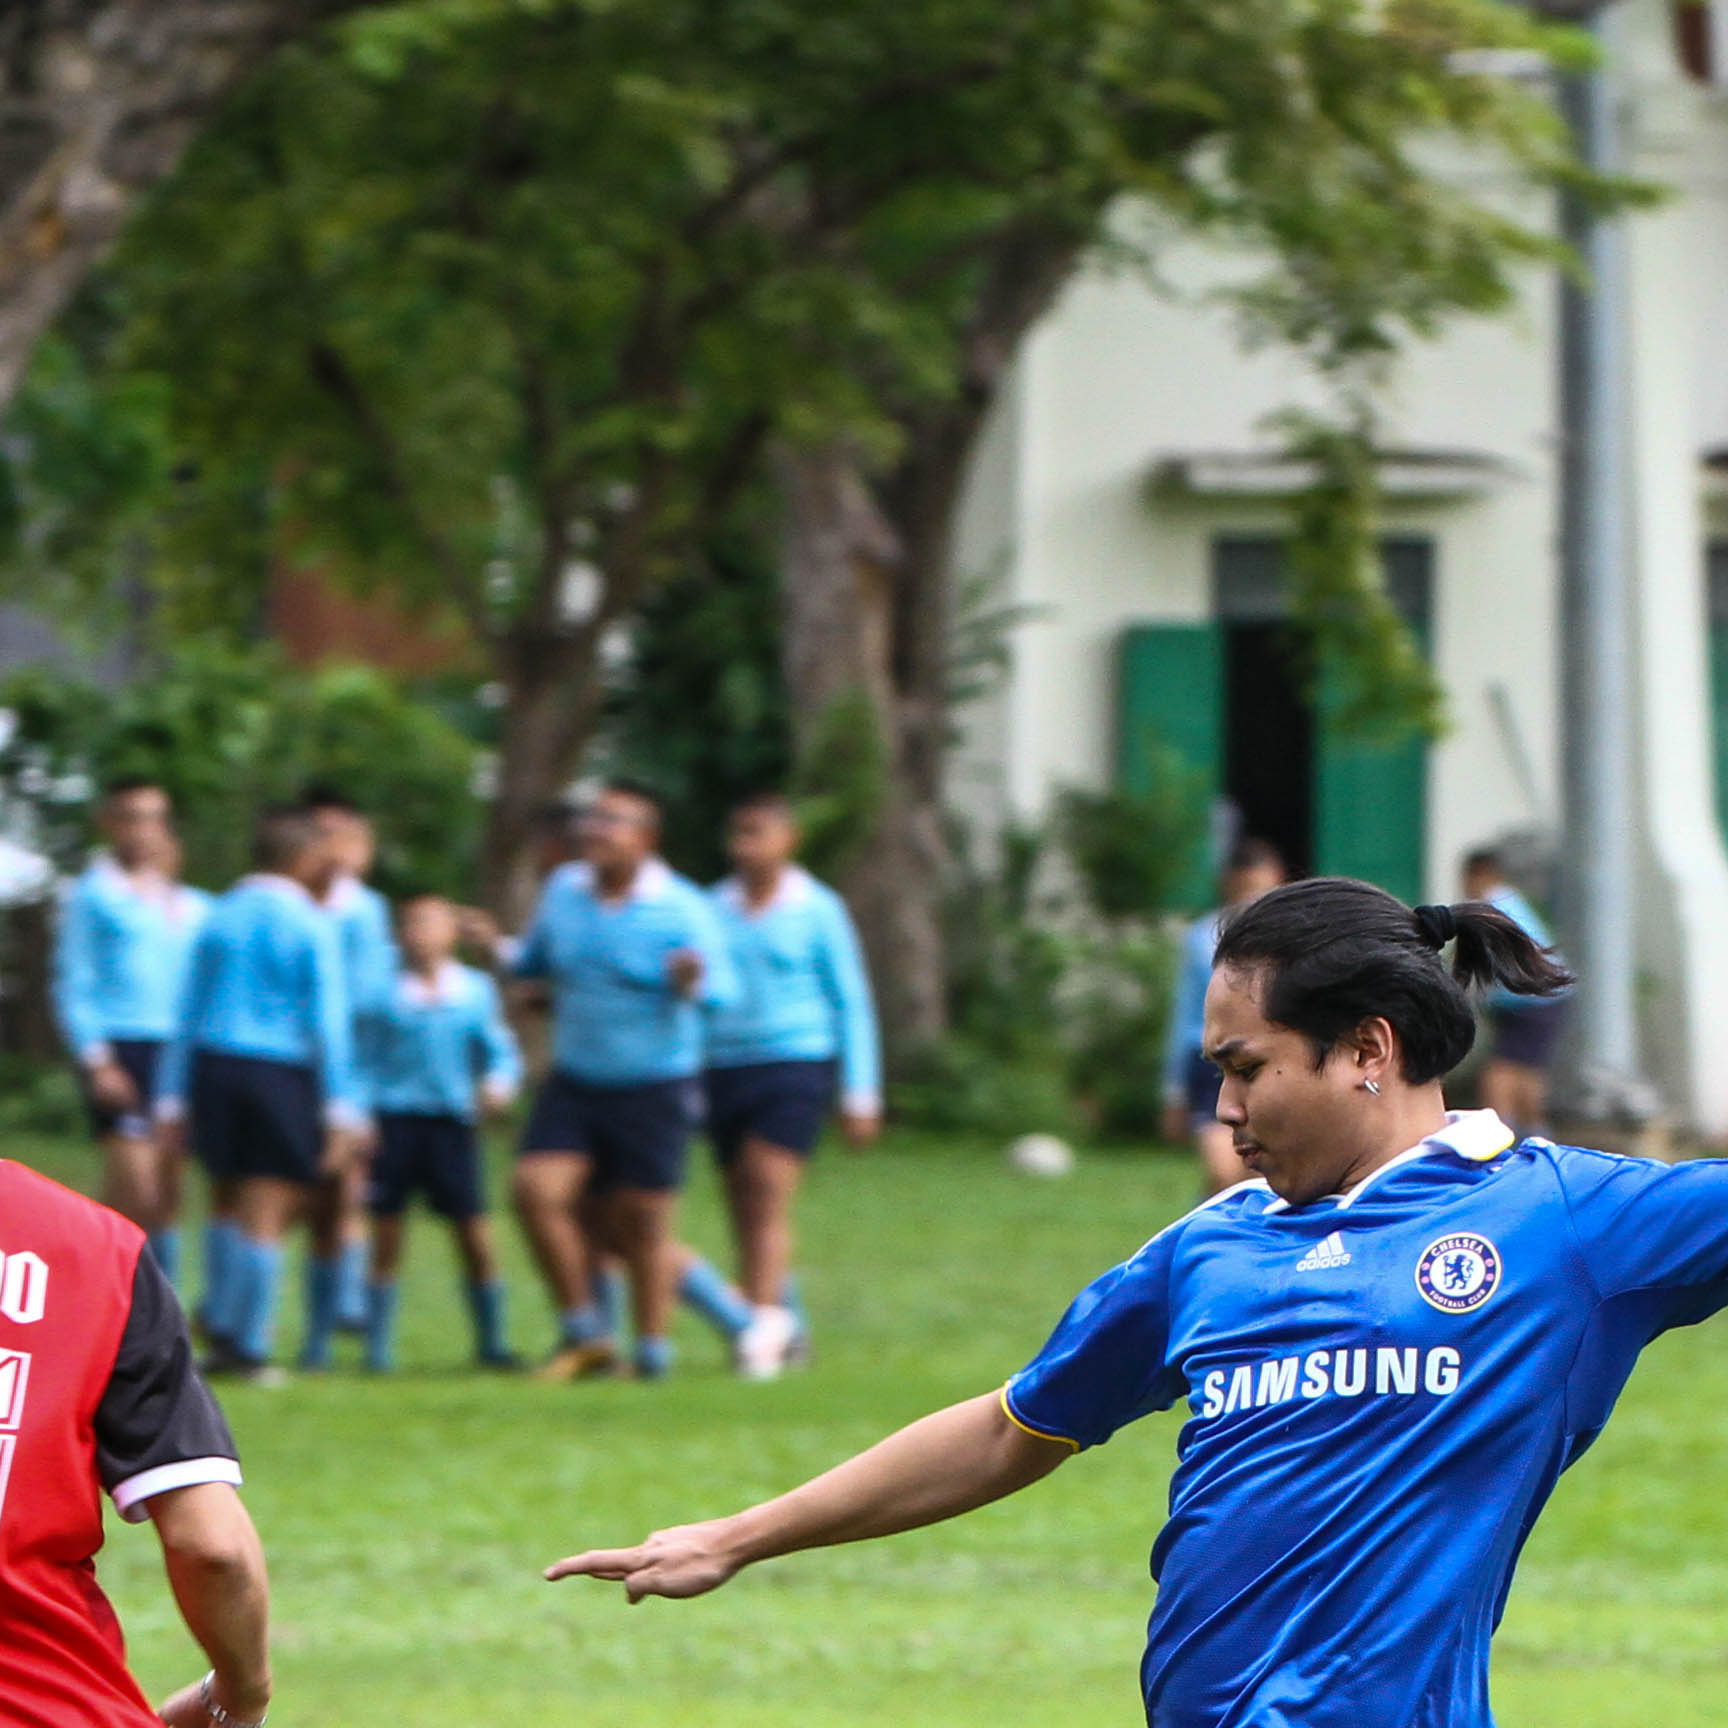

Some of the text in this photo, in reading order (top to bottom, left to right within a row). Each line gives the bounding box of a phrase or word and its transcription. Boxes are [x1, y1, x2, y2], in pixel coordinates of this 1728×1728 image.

[1430, 1238, 1485, 1257] CHELSEA
[1295, 1253, 1352, 1273] adidas
[1429, 1288, 1487, 1308] FOOTBALL CLUB
[1202, 1346, 1461, 1419] SAMSUNG
